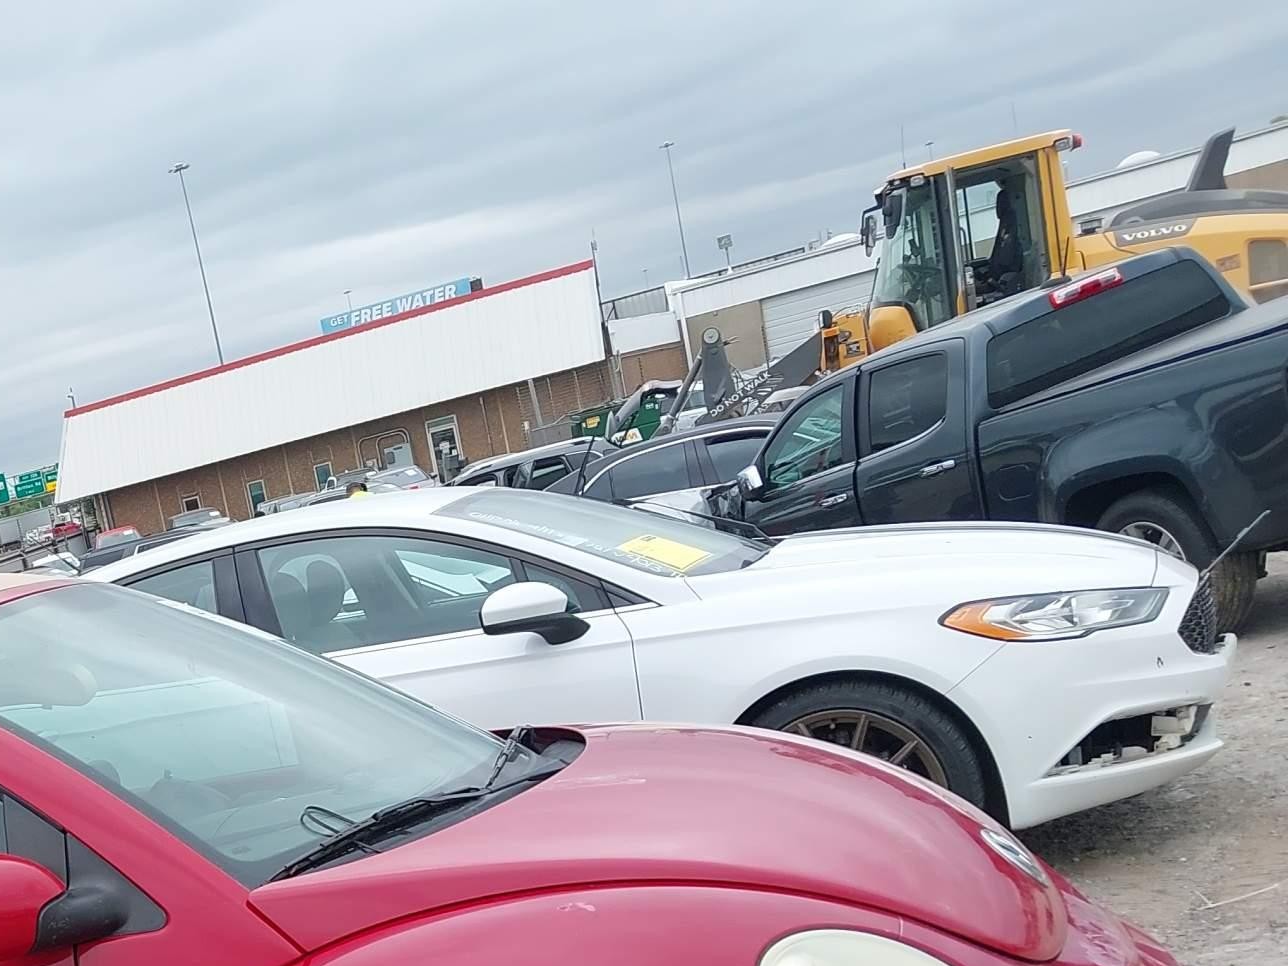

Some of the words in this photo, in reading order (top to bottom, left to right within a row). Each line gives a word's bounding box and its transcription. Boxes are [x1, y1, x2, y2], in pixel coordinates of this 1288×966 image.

[1122, 224, 1187, 241] VOLVO
[330, 315, 348, 327] GET
[350, 302, 392, 327] FREE
[396, 285, 456, 311] WATER
[710, 404, 725, 417] DO
[724, 389, 745, 407] NOT
[744, 370, 772, 391] WALK
